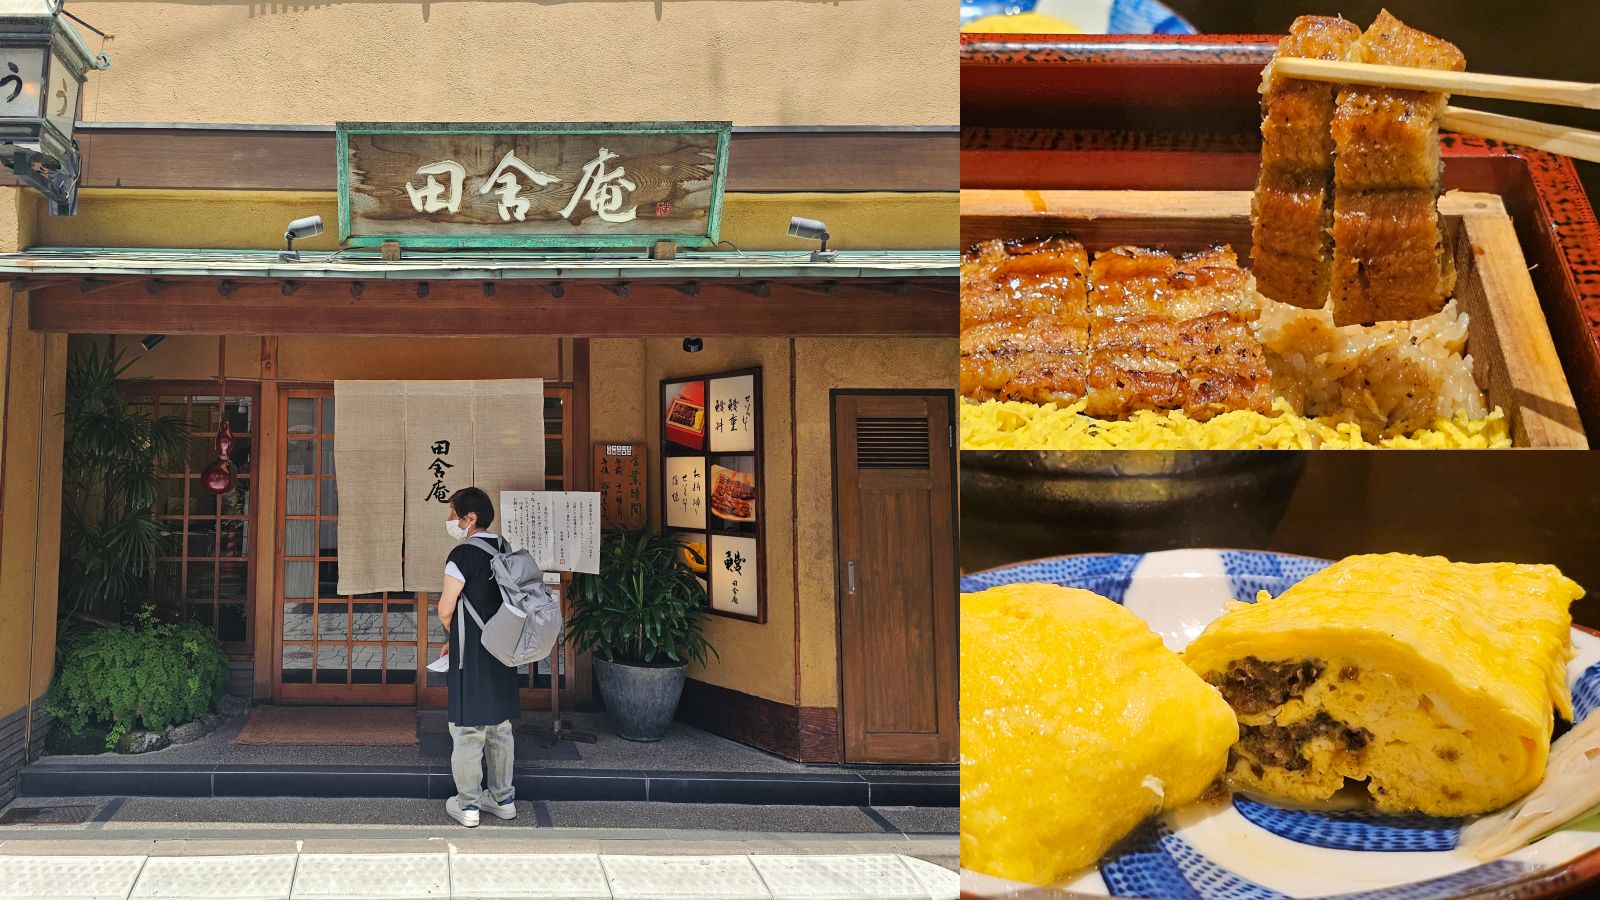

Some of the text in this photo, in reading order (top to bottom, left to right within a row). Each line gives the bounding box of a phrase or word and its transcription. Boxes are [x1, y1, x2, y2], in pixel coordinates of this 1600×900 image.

[0, 61, 23, 103] う
[56, 78, 68, 117] う
[405, 148, 638, 223] 田舎庵
[424, 439, 454, 503] 田舎庵
[724, 550, 747, 576] 鰻
